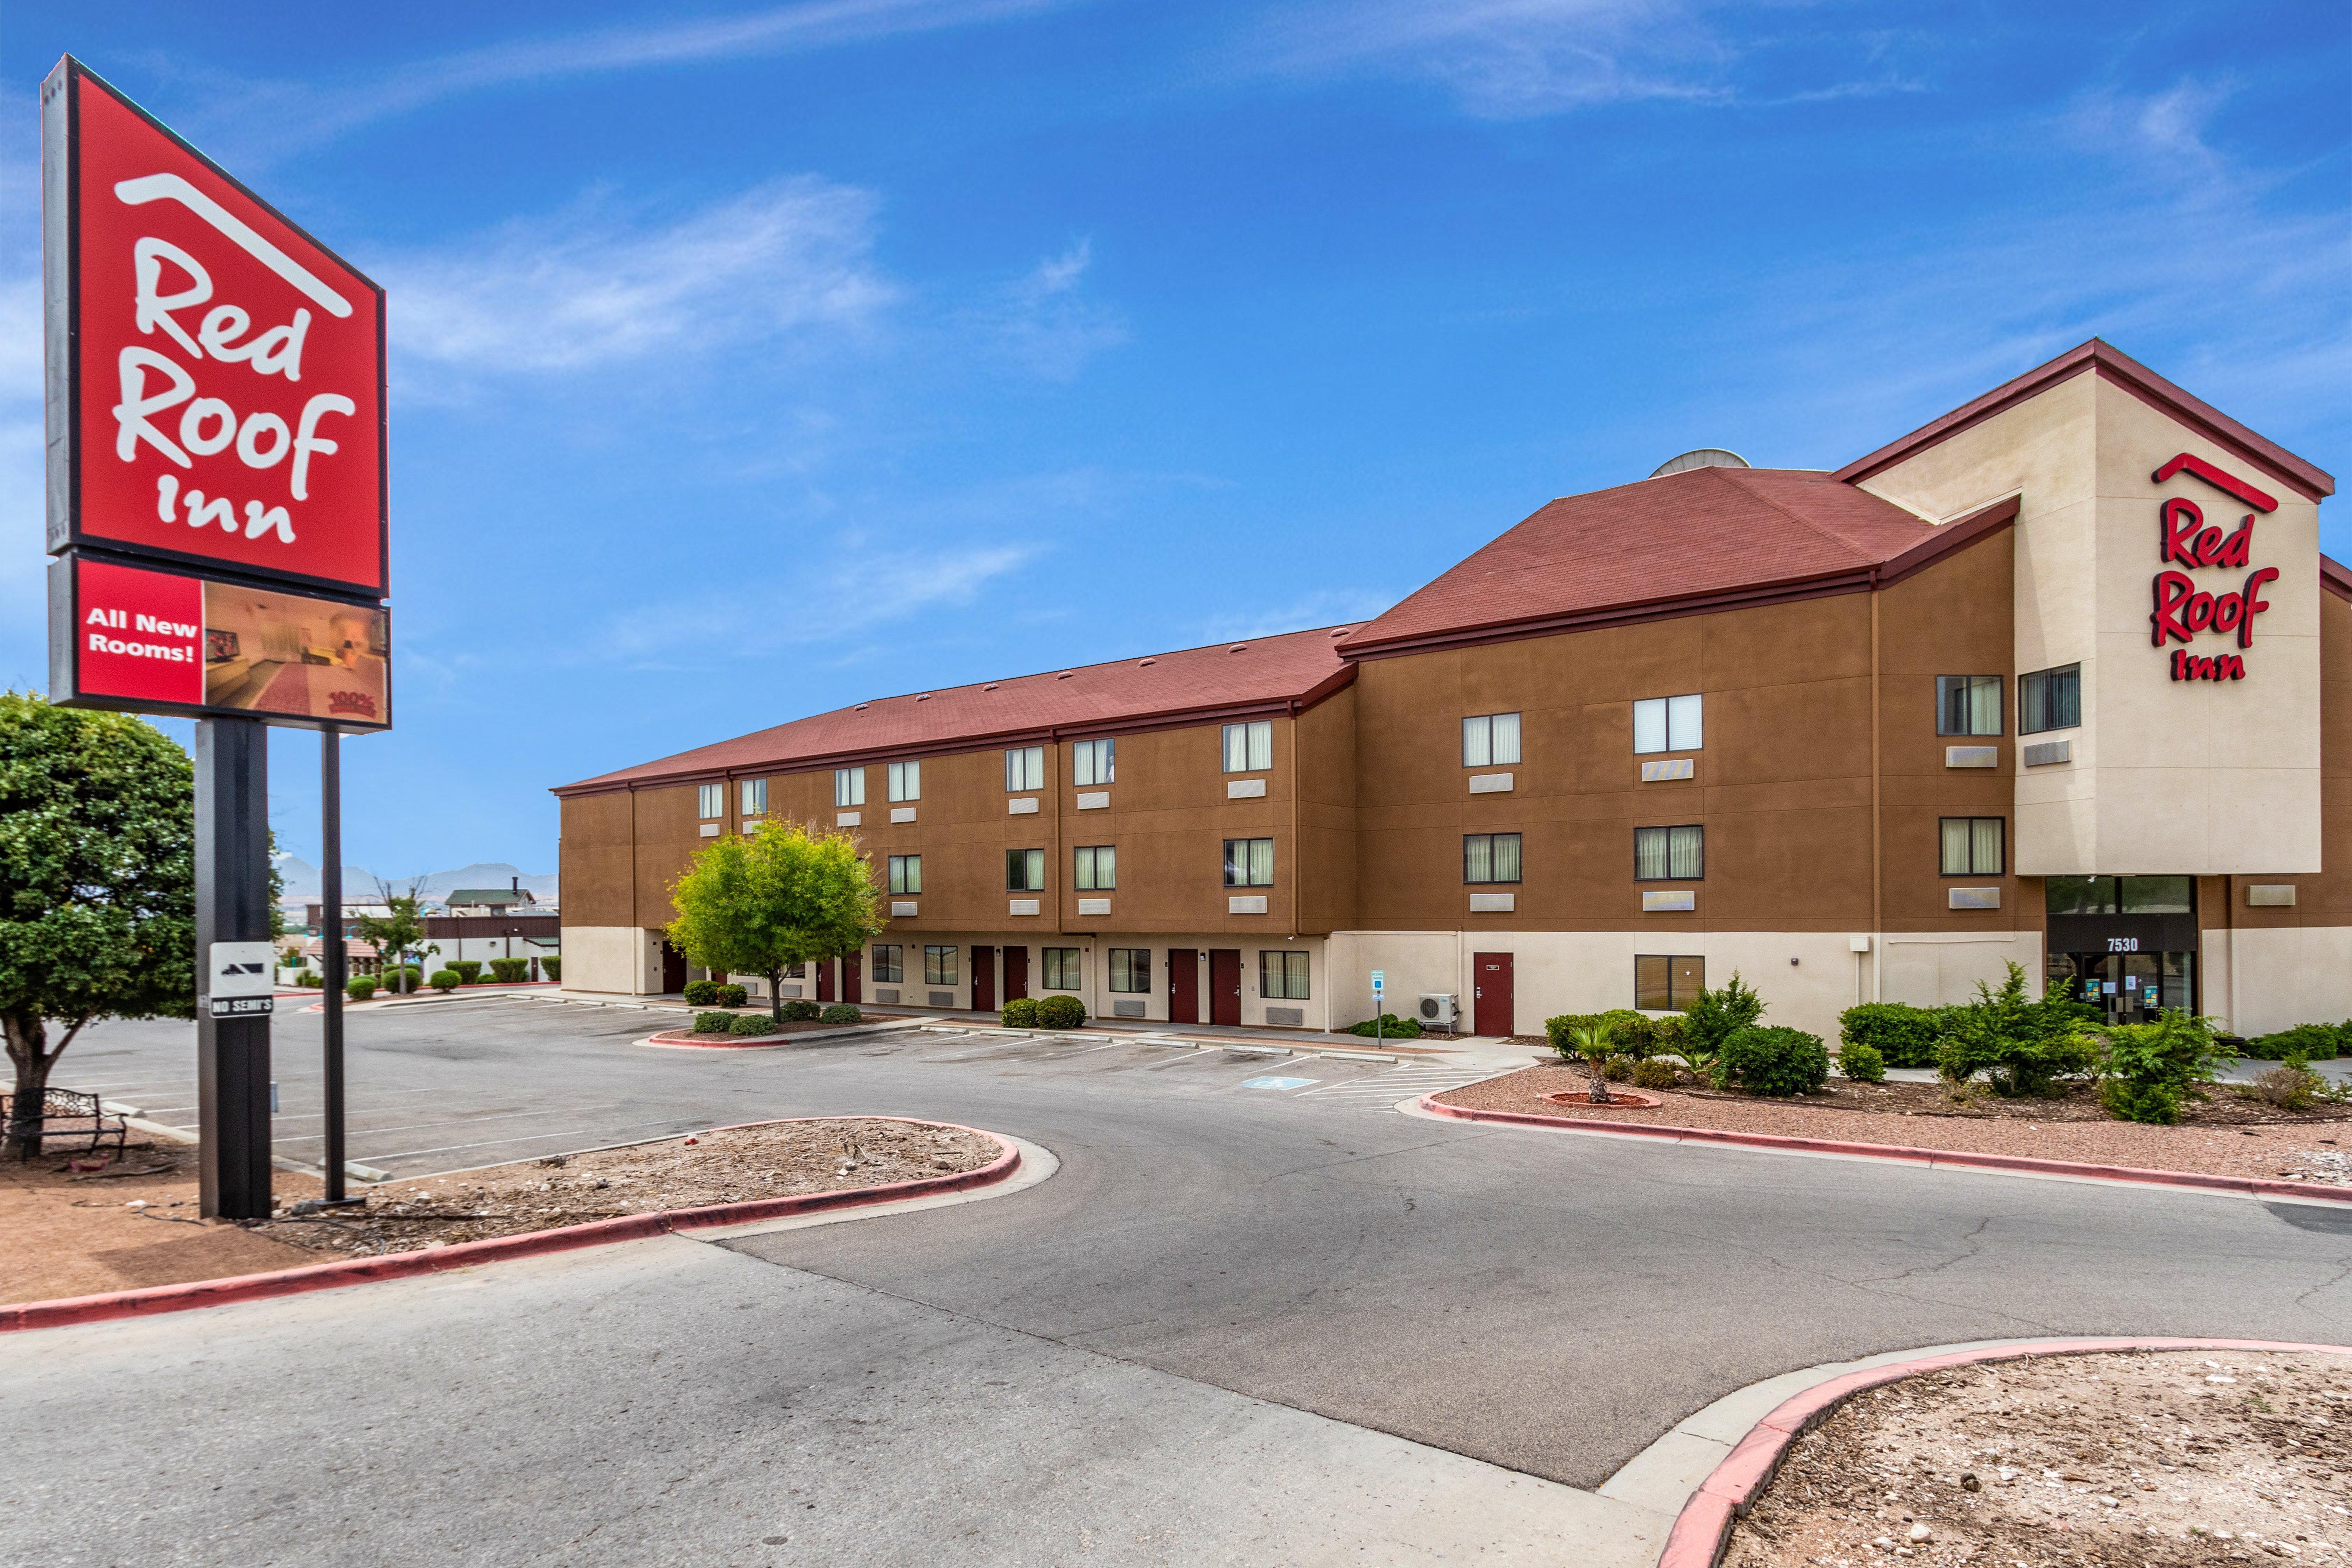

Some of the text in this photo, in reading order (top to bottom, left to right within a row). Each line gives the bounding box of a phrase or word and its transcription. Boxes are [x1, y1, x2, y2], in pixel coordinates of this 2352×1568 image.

[134, 237, 312, 382] Red
[112, 346, 356, 501] Roof
[2159, 497, 2255, 569] Red
[86, 608, 198, 638] All New
[2149, 567, 2279, 649] Roof
[89, 633, 193, 662] Rooms!
[2107, 938, 2138, 951] 7530
[212, 1001, 229, 1013] NO
